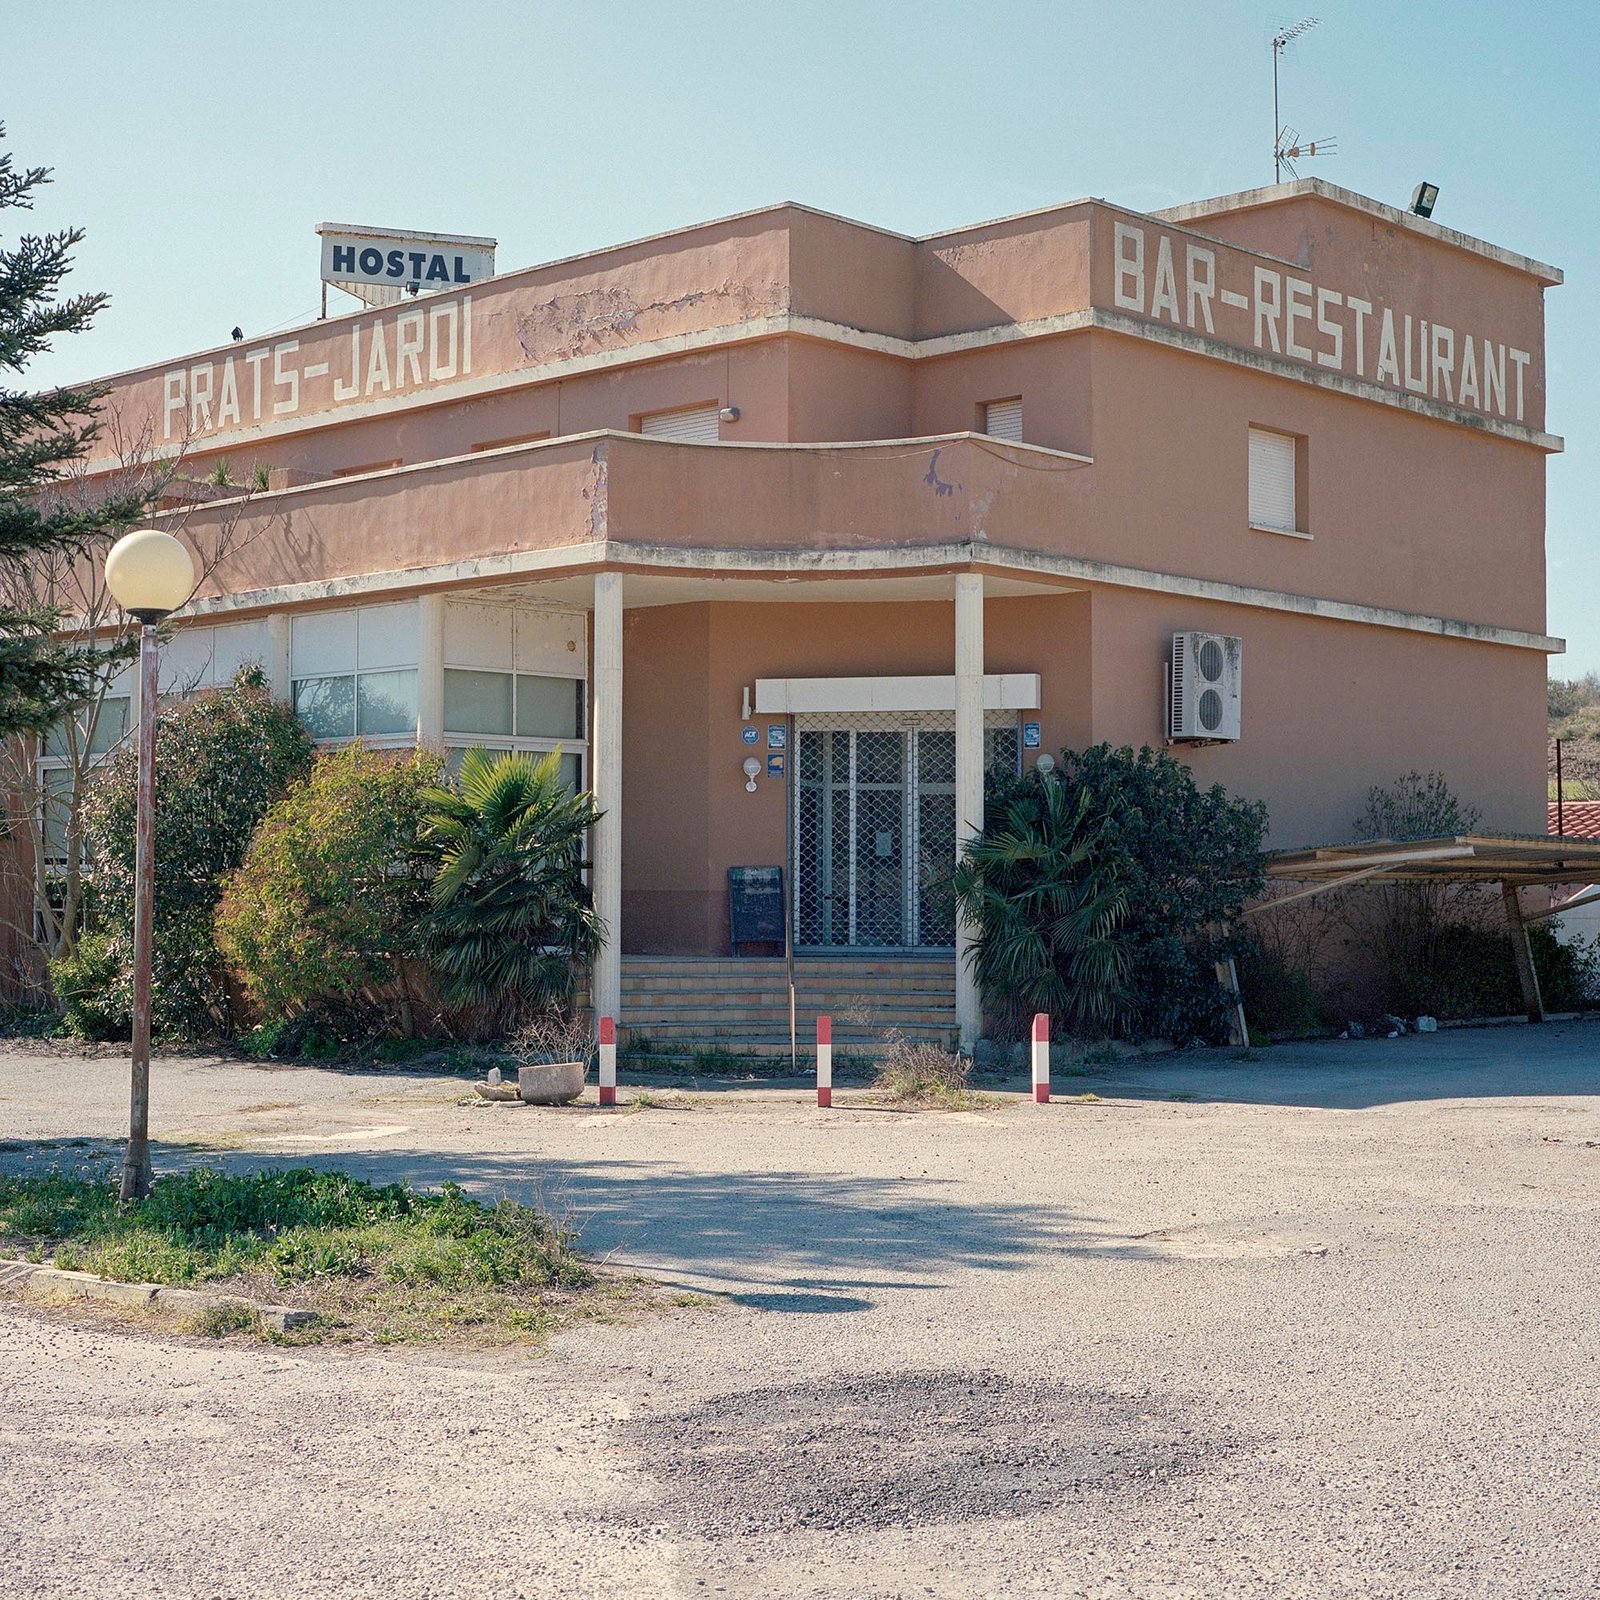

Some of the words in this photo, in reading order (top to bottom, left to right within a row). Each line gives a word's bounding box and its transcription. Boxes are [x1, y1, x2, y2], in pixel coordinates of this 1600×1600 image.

[333, 245, 471, 283] HOSTAL
[1114, 221, 1531, 421] BAR-RESTAURANT
[163, 295, 472, 439] PRATS-JARDI
